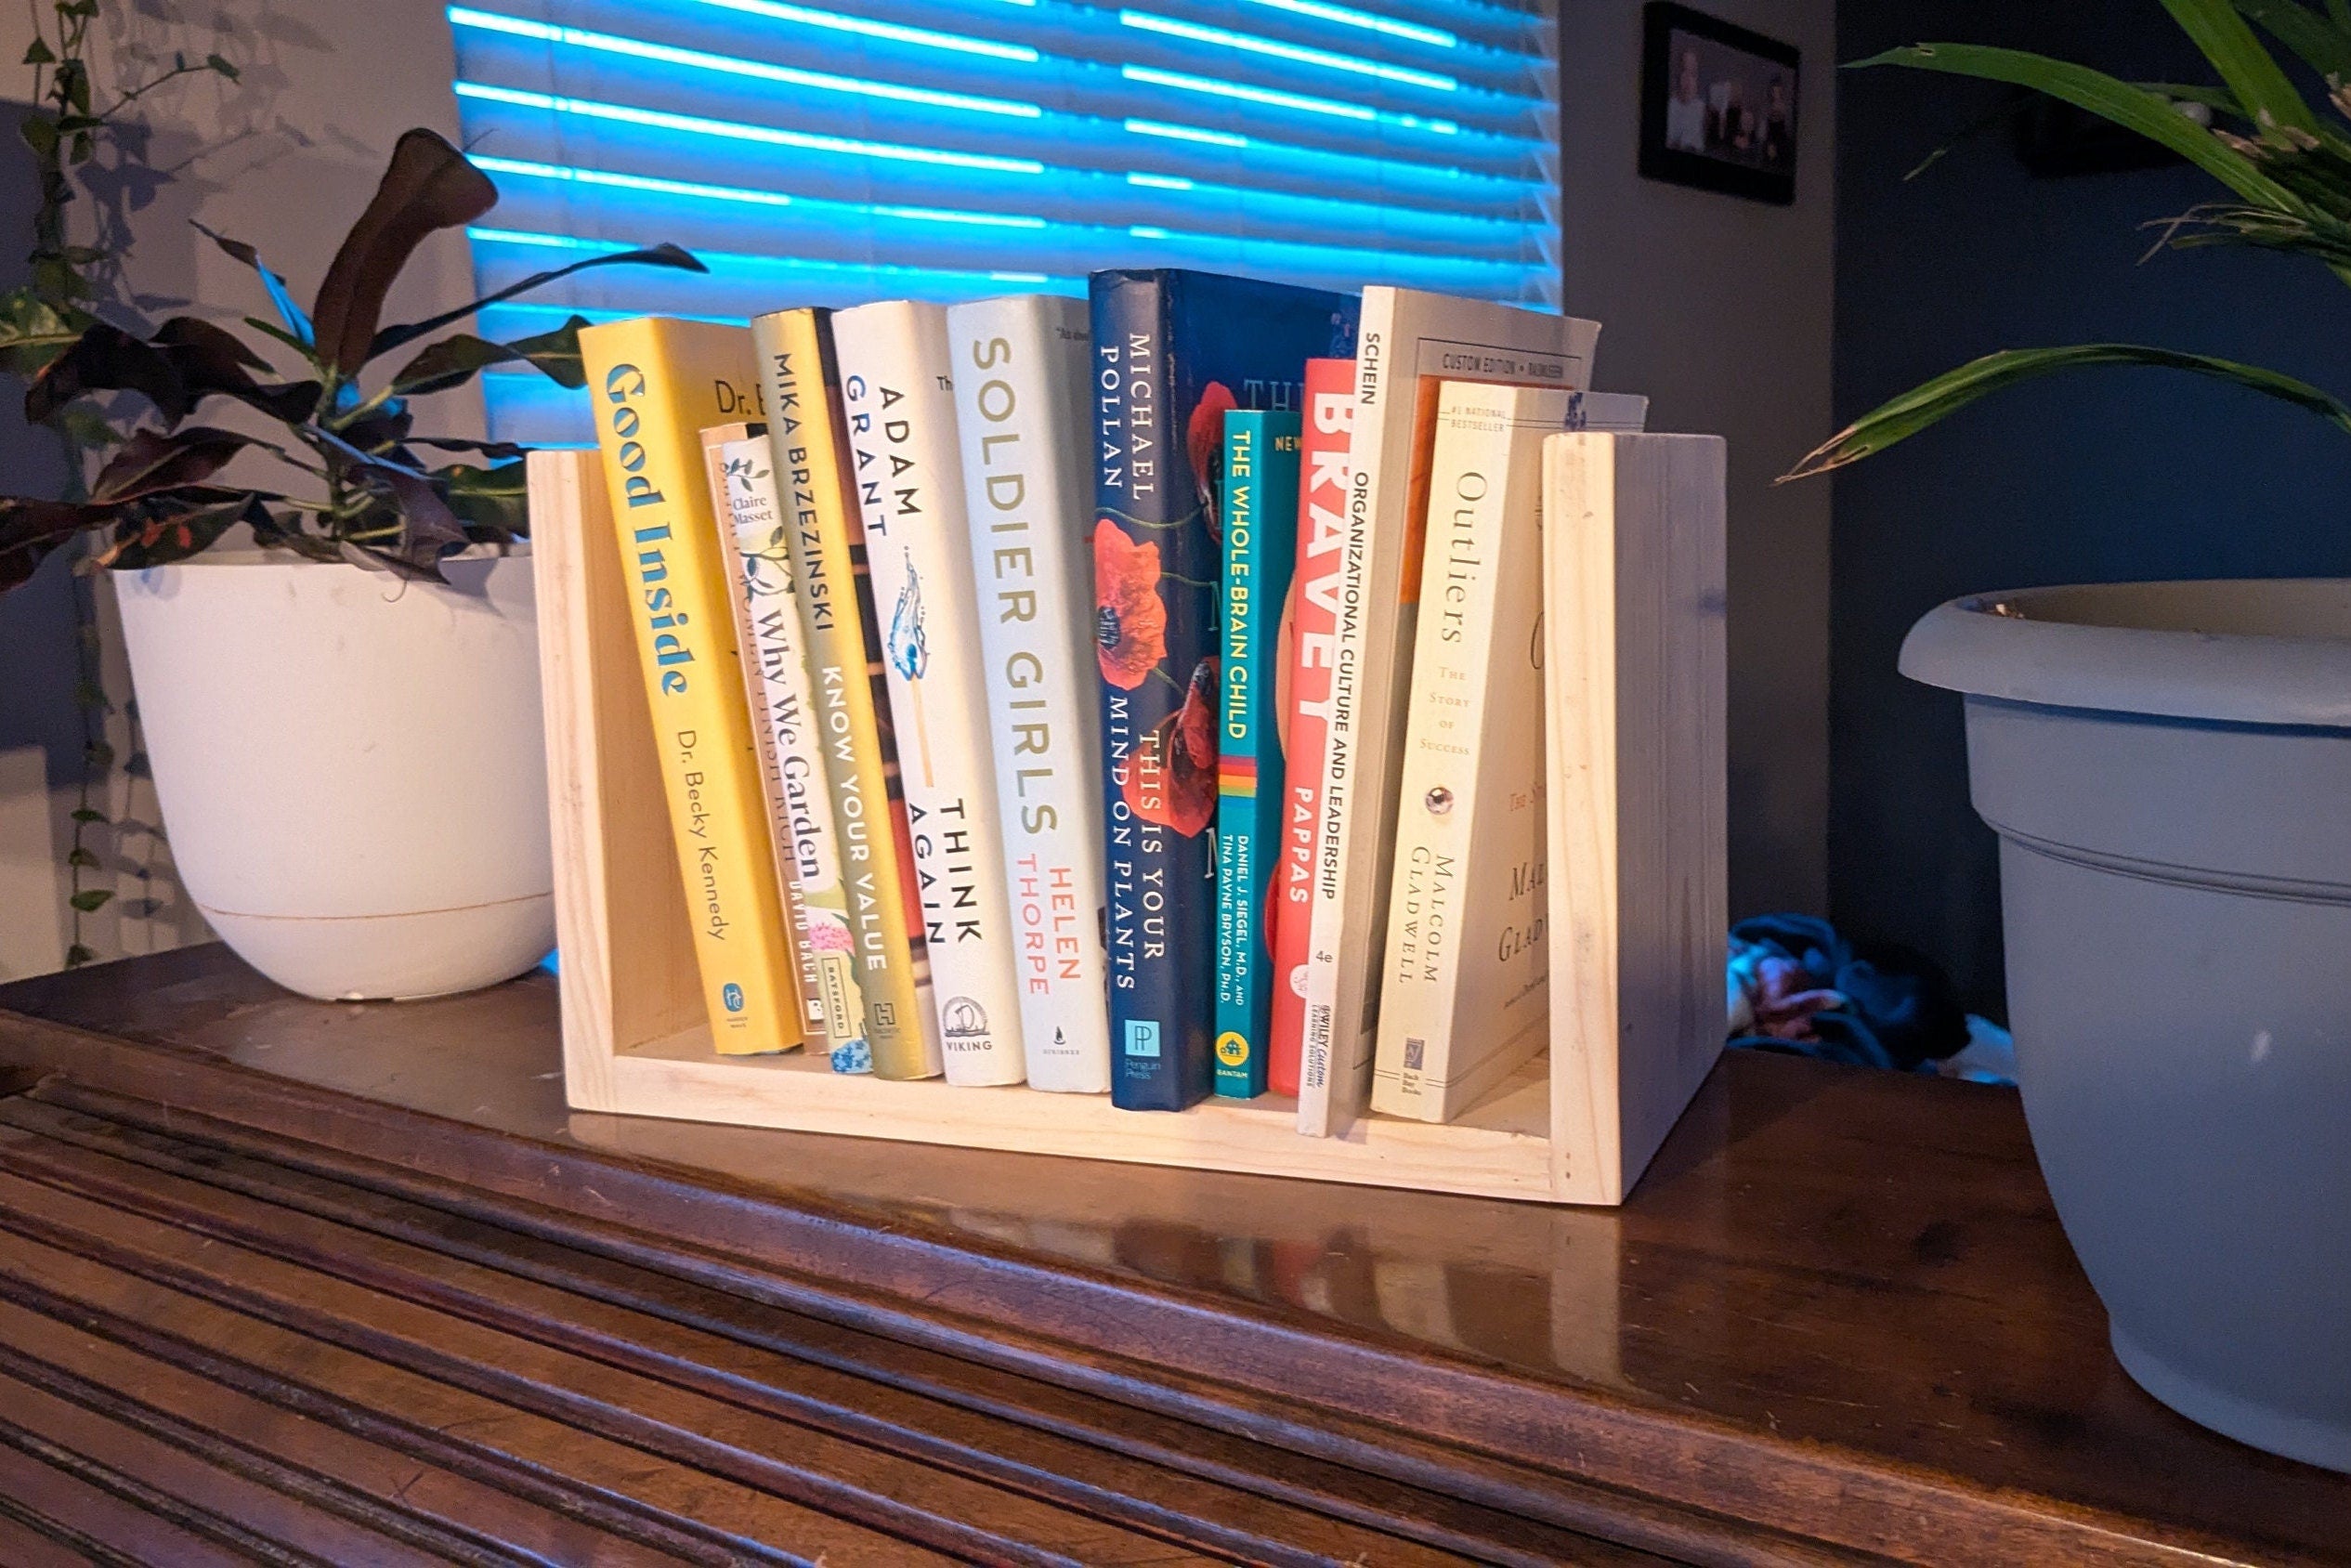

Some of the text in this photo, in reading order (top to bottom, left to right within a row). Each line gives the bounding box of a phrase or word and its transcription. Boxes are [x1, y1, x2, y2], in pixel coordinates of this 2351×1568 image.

[714, 380, 751, 415] Dr.
[936, 374, 954, 391] Th
[1360, 333, 1380, 405] SCHEIN
[1443, 353, 1481, 372] CUSTOM
[1483, 357, 1516, 374] EDITION
[879, 385, 922, 516] ADAM
[1100, 346, 1123, 489] POLLAN
[1129, 333, 1155, 501] MICHAEL
[1450, 418, 1506, 432] BESTSELLER
[1451, 405, 1507, 419] #1 NATIONAL
[774, 353, 833, 631] MIKA BRZEZINSKI
[846, 374, 887, 536] GRANT
[607, 363, 695, 697] Good Inside
[732, 496, 767, 511] Claire
[733, 510, 773, 525] Masset
[973, 337, 1058, 834] SOLDIER GIRLS
[1228, 430, 1251, 739] THE WHOLE-BRAIN CHILD
[1442, 471, 1488, 643] Outliers
[1322, 471, 1369, 900] ORGANIZATIONAL CULTURE AND LEADERSHIP
[758, 609, 822, 878] Why We Garden
[677, 730, 729, 940] Dr. Becky Kennedy
[822, 666, 887, 972] KNOW YOUR VALUE
[1109, 695, 1135, 989] MIND ON PLANTS
[1139, 729, 1165, 960] THIS IS YOUR
[1221, 834, 1234, 864] TINA
[1236, 834, 1249, 882] DANIEL
[1289, 787, 1314, 904] PAPPAS
[908, 803, 946, 943] AGAIN
[939, 798, 983, 943] THINK
[1221, 868, 1233, 909] PAYNE
[1236, 887, 1248, 896] J.
[1017, 853, 1050, 995] THORPE
[1049, 868, 1081, 979] HELEN
[1220, 913, 1233, 969] BRYSON,
[1235, 900, 1248, 947] SIEGEL,
[1315, 949, 1334, 964] 4e
[1399, 845, 1431, 984] GLADWELL
[1423, 854, 1456, 982] MALCOLM
[828, 966, 843, 1030] BATSFORD
[1234, 985, 1245, 1006] AND
[1318, 1013, 1330, 1048] WILEY
[946, 1039, 993, 1052] VIKING
[1125, 1058, 1161, 1070] Penguin
[1125, 1069, 1152, 1079] Press
[1217, 1068, 1248, 1078] BANTAM
[1306, 1004, 1318, 1088] LEARNING SOLUTIONS
